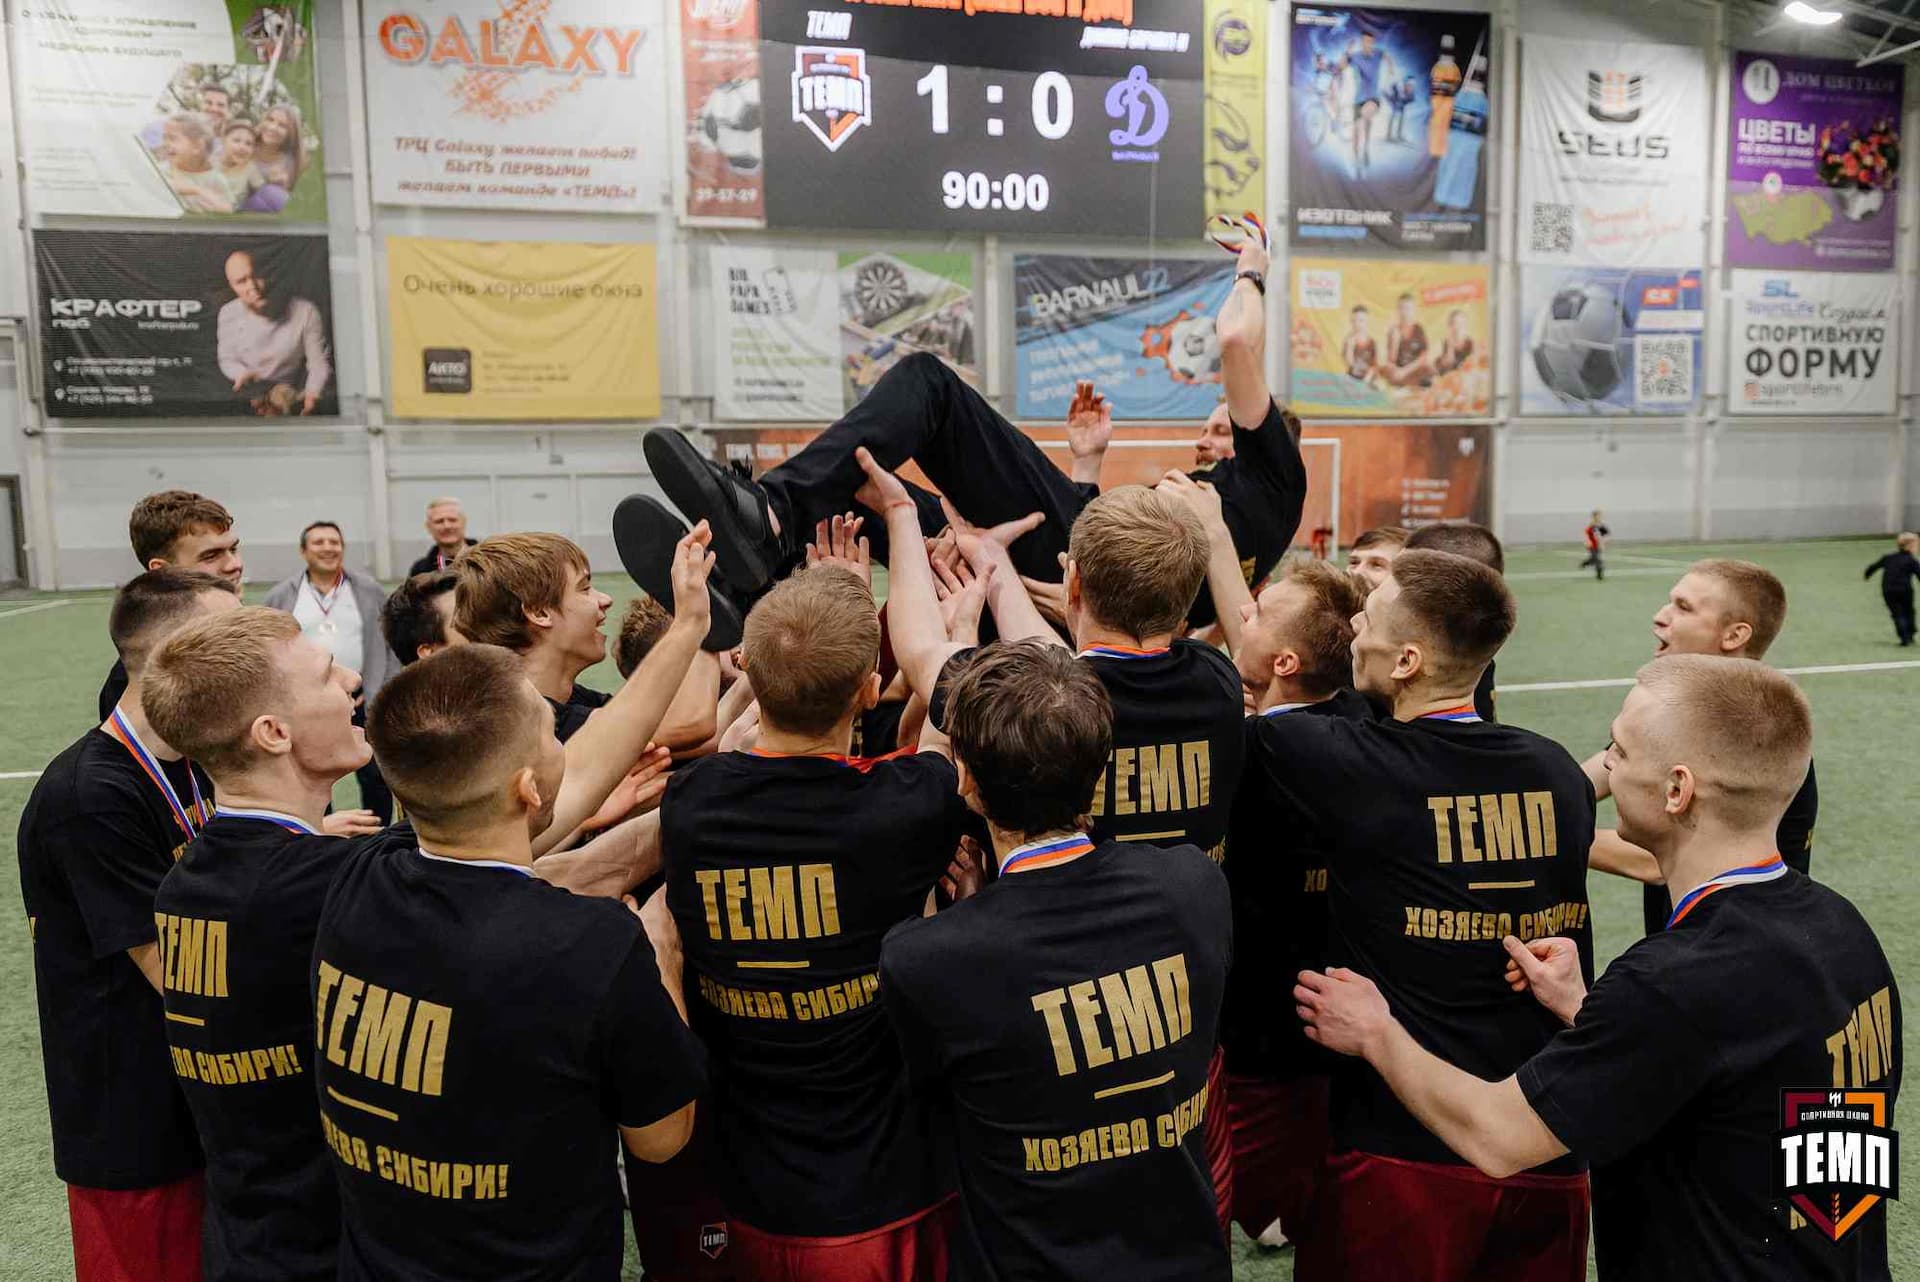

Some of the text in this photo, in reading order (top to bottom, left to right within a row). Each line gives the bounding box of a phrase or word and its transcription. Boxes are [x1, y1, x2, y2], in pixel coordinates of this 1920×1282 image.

[378, 14, 643, 77] GALAXY
[799, 75, 864, 114] ТЕМП
[917, 65, 949, 133] 1
[1032, 71, 1074, 139] 0
[1738, 118, 1816, 144] ЦВЕТЫ
[942, 171, 1049, 211] 90:00
[51, 298, 202, 318] КРАФТЕР
[403, 274, 644, 302] Очень хорошие окна
[1745, 324, 1885, 343] СПОРТИВНУЮ
[1745, 348, 1882, 379] ФОРМУ
[1427, 791, 1557, 863] ТЕМП
[695, 864, 841, 941] ТЕМП
[1404, 907, 1512, 941] ХОЗЯЕВА
[154, 912, 228, 998] ТЕМП
[792, 969, 880, 1022] СИБИР
[1031, 953, 1192, 1077] ТЕМП
[316, 960, 453, 1097] ТЕМП
[195, 1044, 304, 1085] СИБИРИ!
[1023, 1118, 1149, 1172] ХОЗЯЕВА
[376, 1145, 509, 1200] СИБИРИ!
[703, 1233, 725, 1247] ТЕМП
